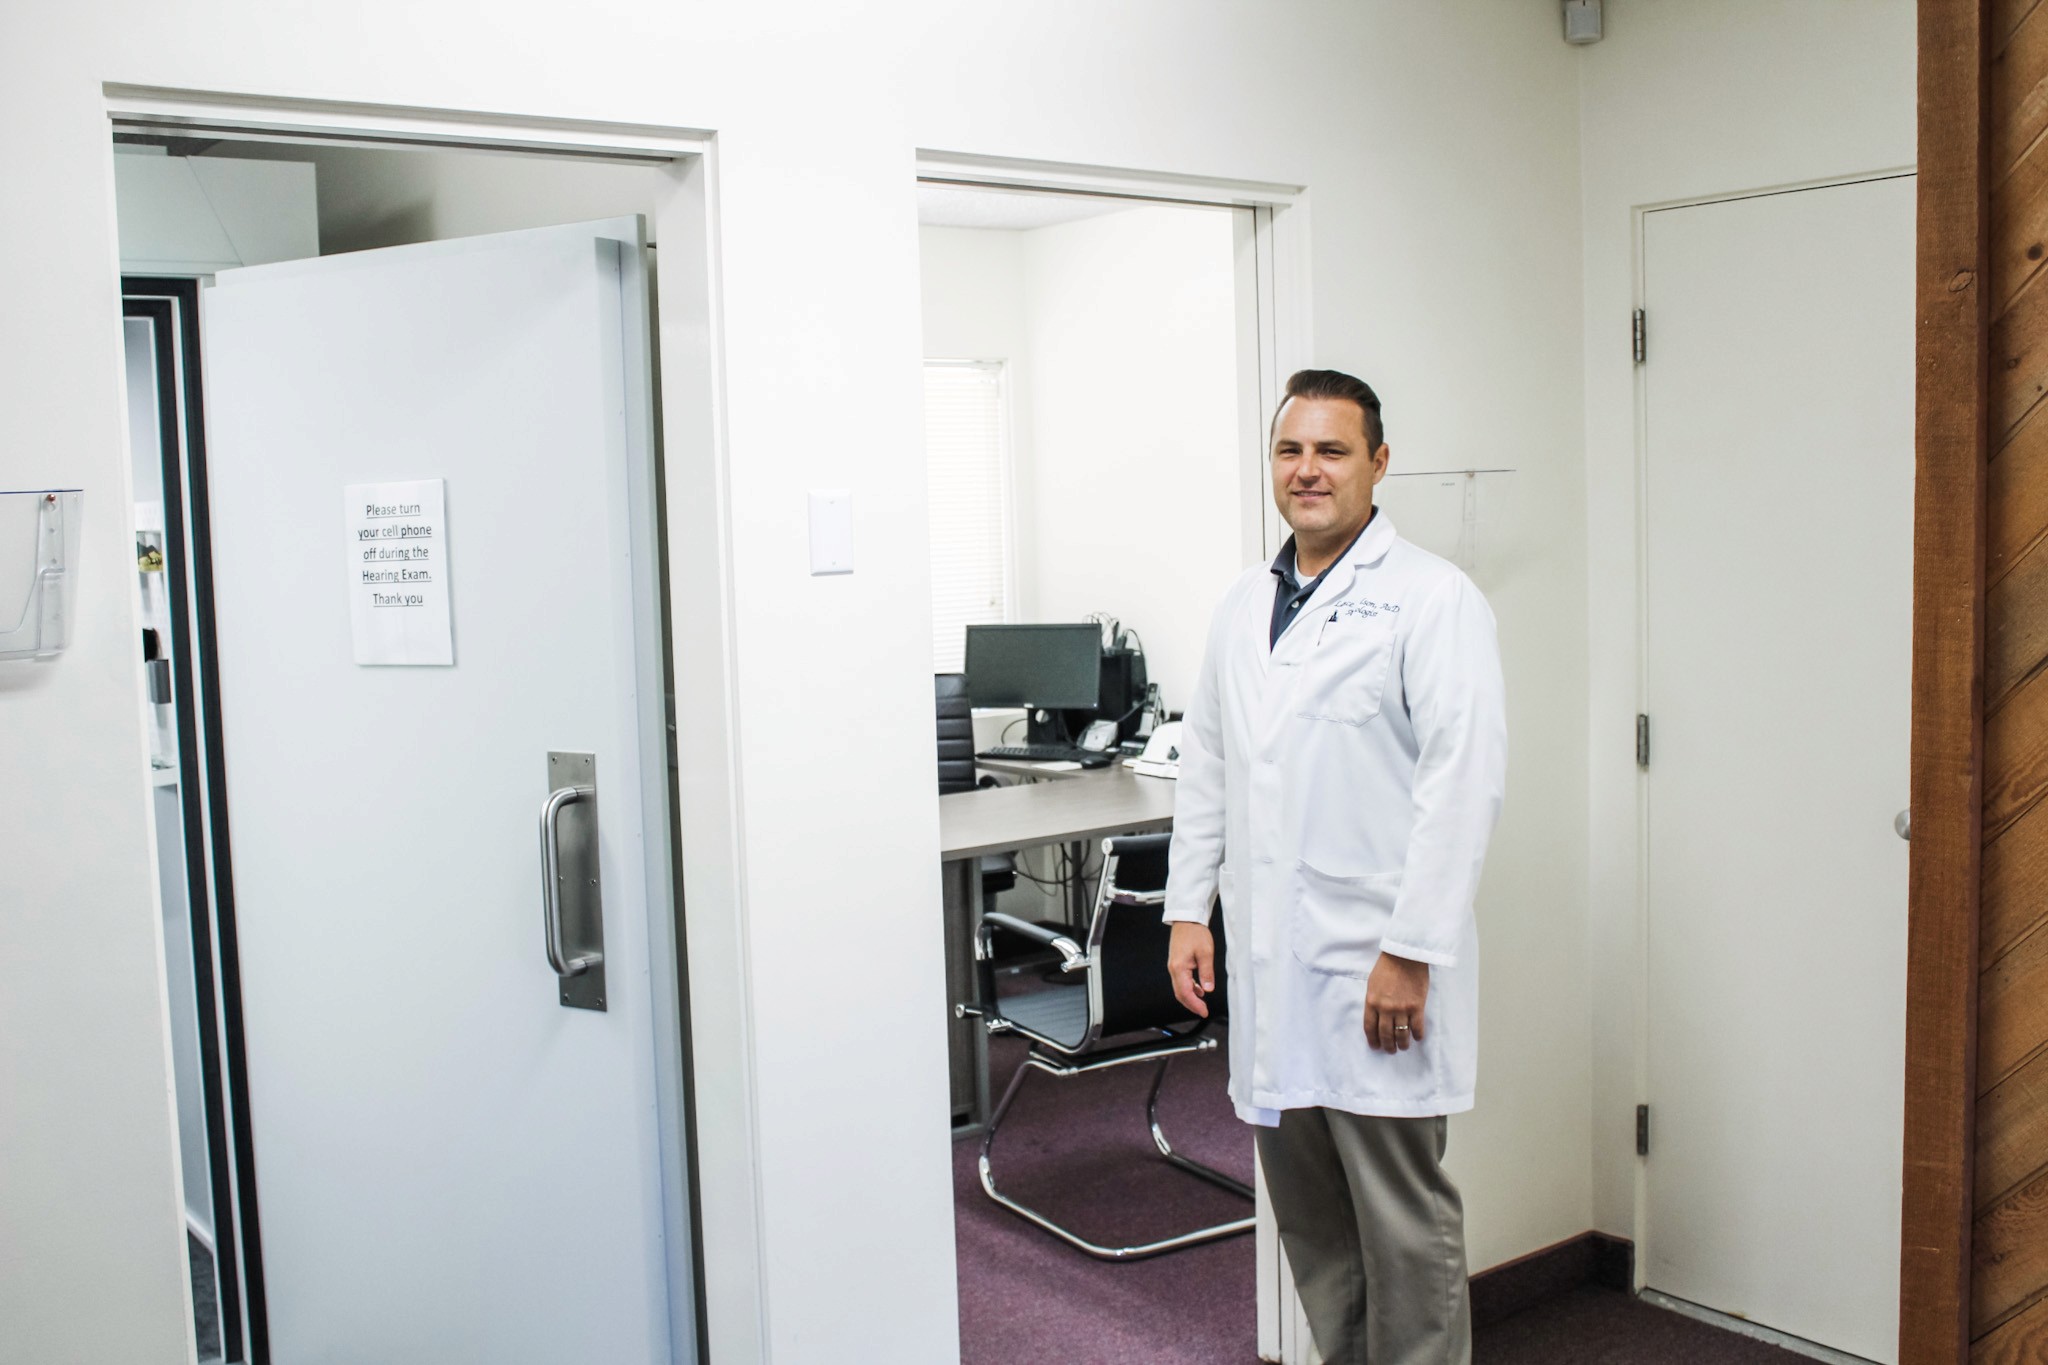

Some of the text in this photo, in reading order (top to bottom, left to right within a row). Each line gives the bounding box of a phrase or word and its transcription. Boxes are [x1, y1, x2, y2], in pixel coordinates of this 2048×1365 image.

[366, 504, 421, 516] Please turn
[358, 524, 432, 541] your cell phone
[363, 545, 429, 561] off during the
[362, 568, 432, 583] Hearing Exam.
[373, 592, 423, 607] Thank you
